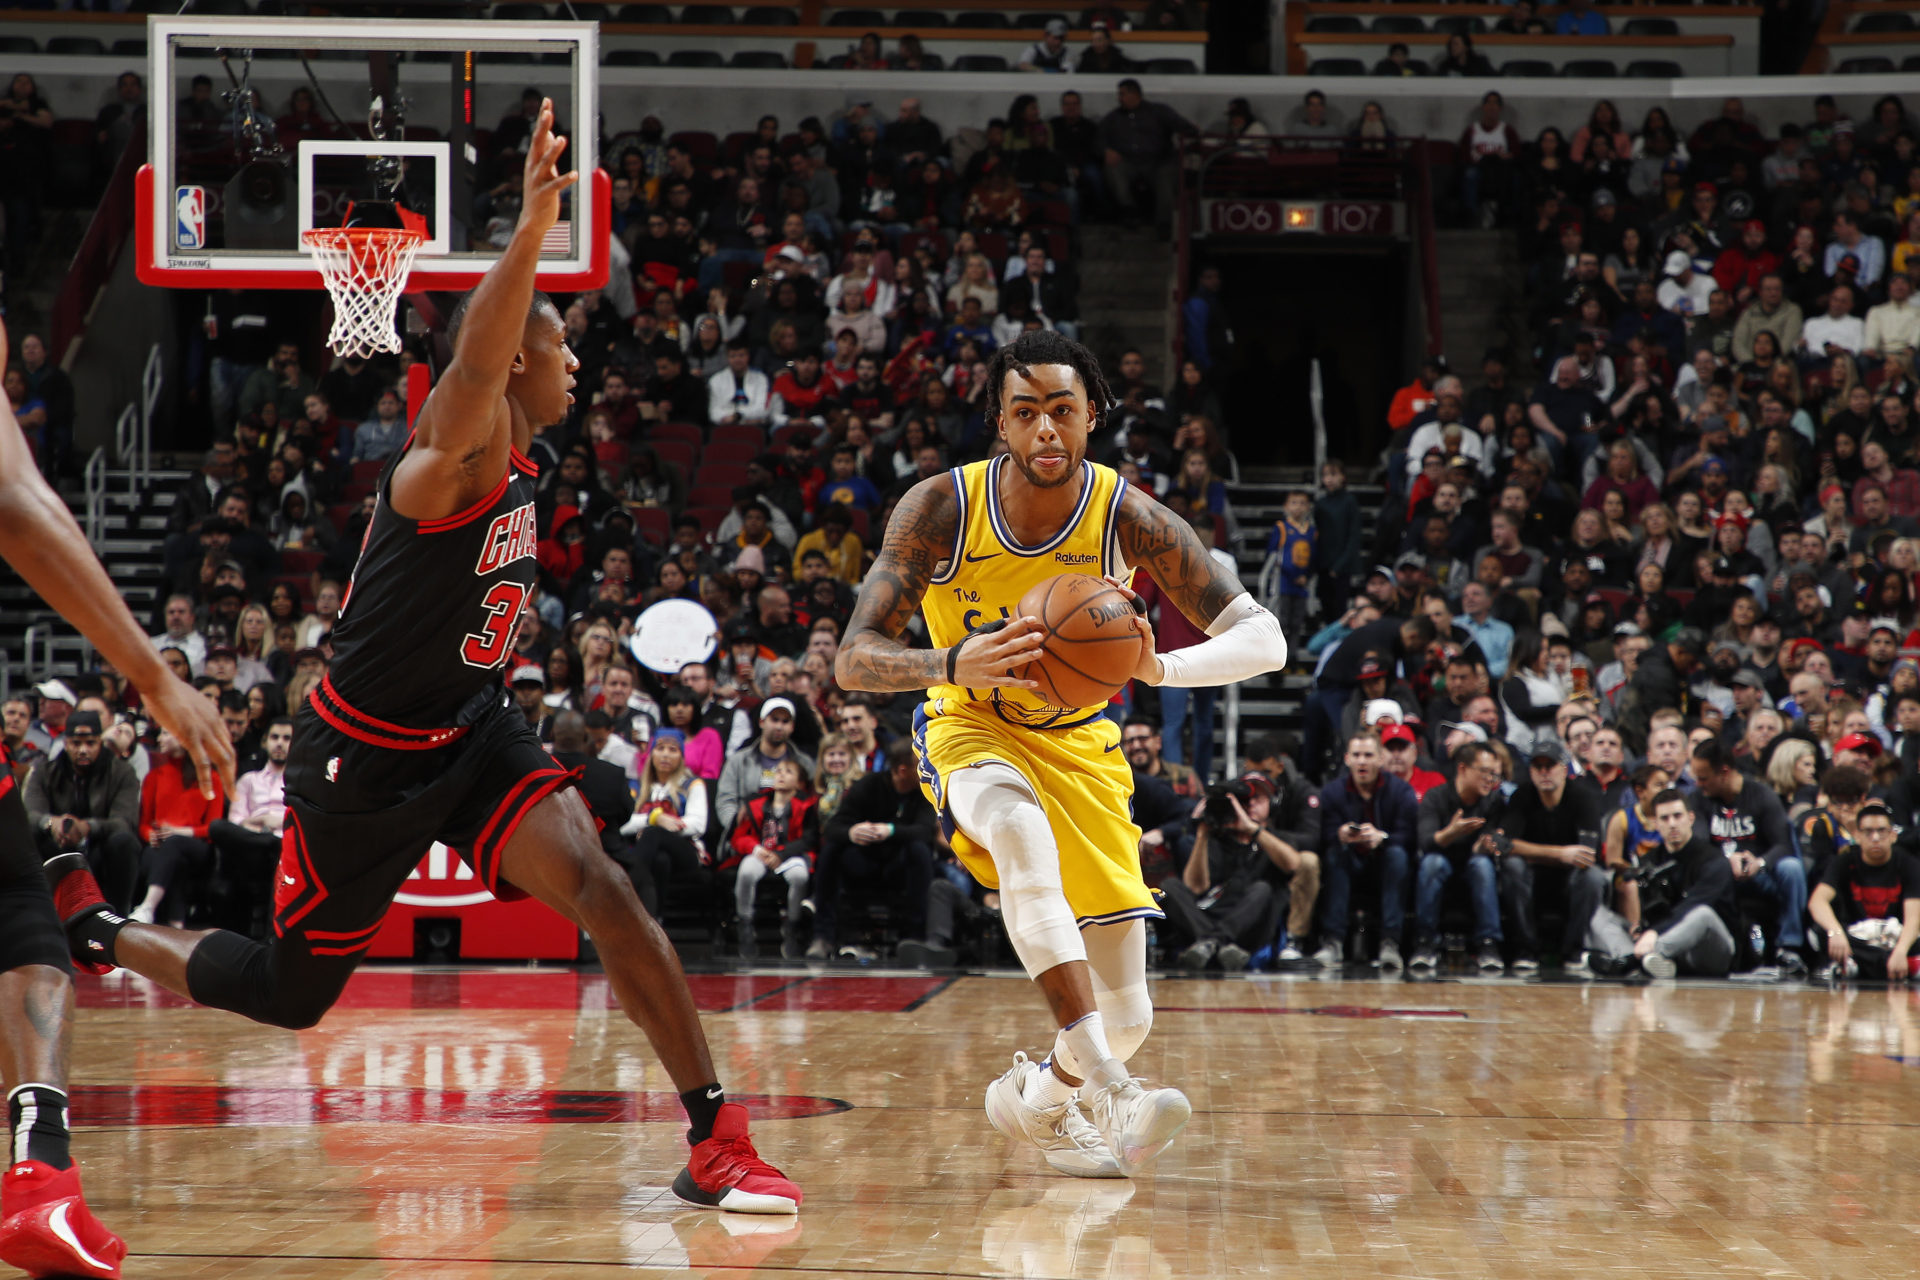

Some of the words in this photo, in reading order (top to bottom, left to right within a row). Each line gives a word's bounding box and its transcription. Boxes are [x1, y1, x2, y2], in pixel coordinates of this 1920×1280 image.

[1218, 204, 1273, 231] 106
[1333, 204, 1381, 232] 107
[168, 258, 210, 270] SPALDING
[1054, 552, 1099, 565] Rakuten
[953, 587, 982, 603] The
[460, 580, 535, 671] 3
[1710, 814, 1756, 837] BULLS
